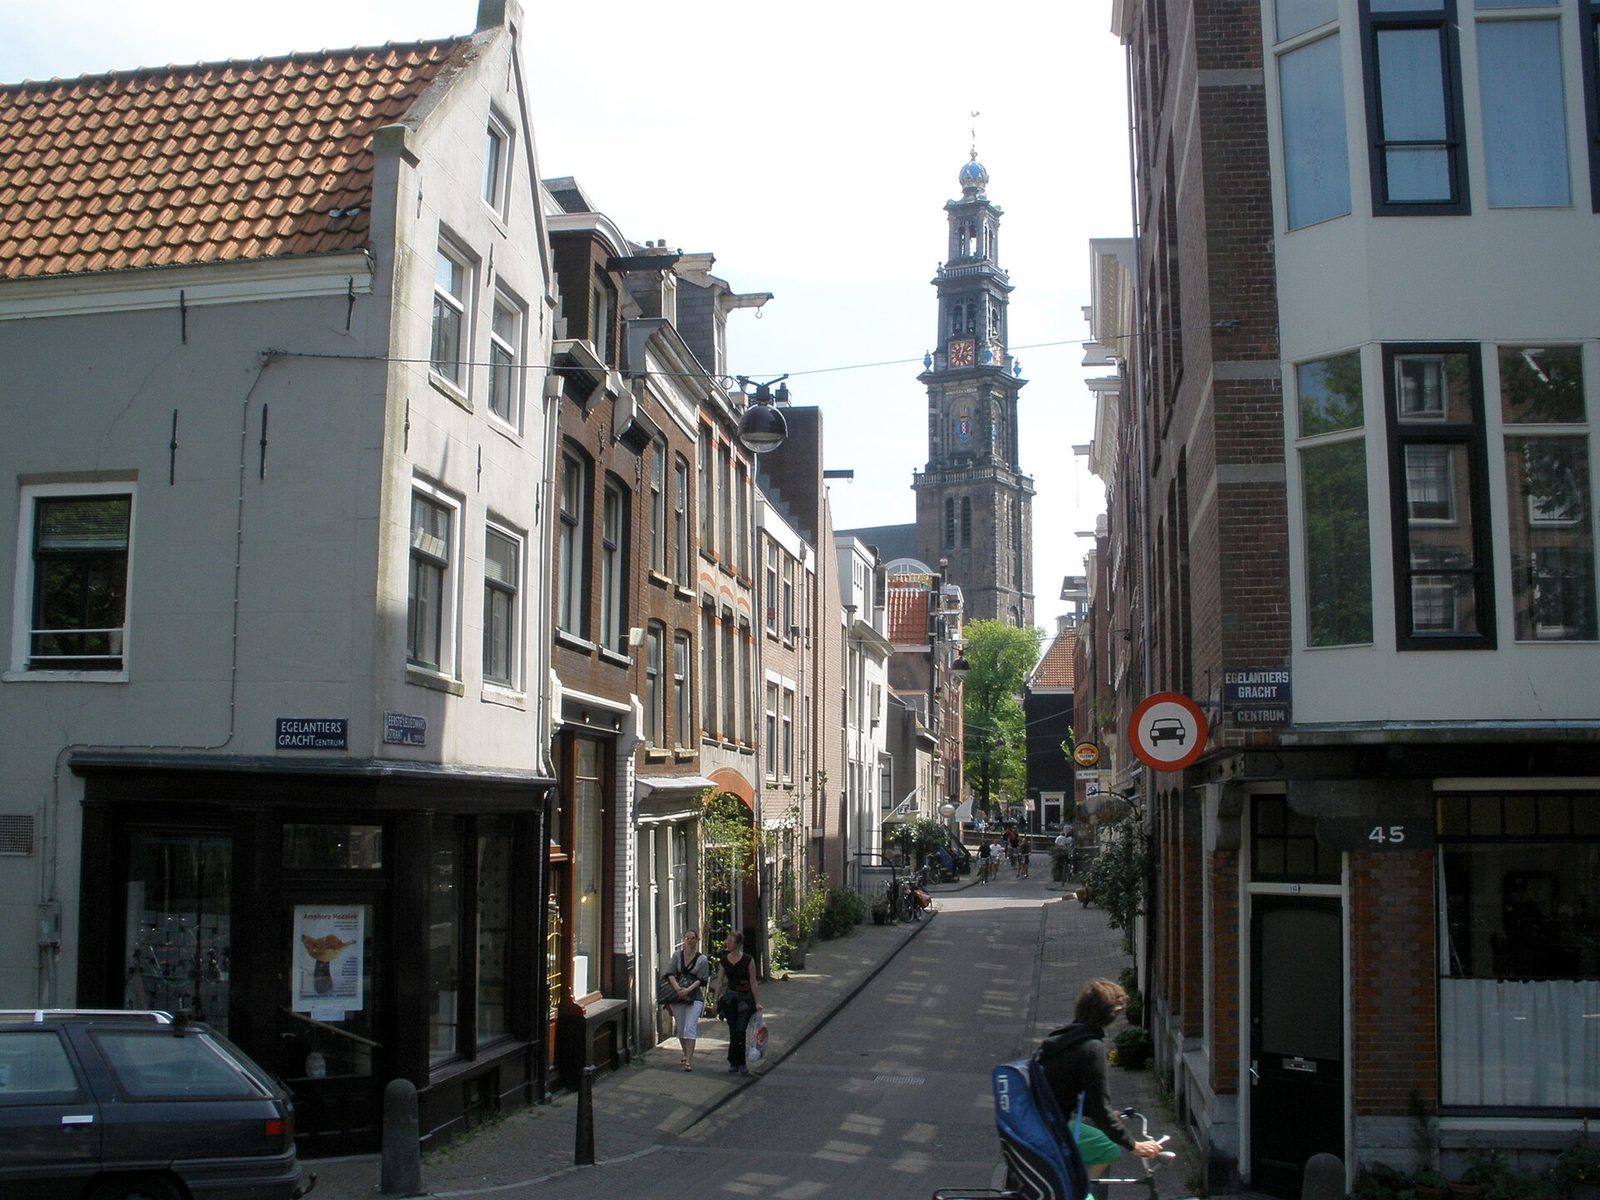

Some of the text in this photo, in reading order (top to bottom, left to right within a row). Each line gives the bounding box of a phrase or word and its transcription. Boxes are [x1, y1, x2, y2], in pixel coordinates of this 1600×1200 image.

[1225, 671, 1289, 684] EGELANTIERS
[1238, 686, 1278, 698] GRACHT
[1237, 710, 1286, 722] CENTRUM
[281, 721, 342, 733] EGELANTIERS
[278, 734, 345, 747] GRACHT CENTRUM
[1368, 825, 1405, 844] 45
[303, 913, 332, 921] Amphora
